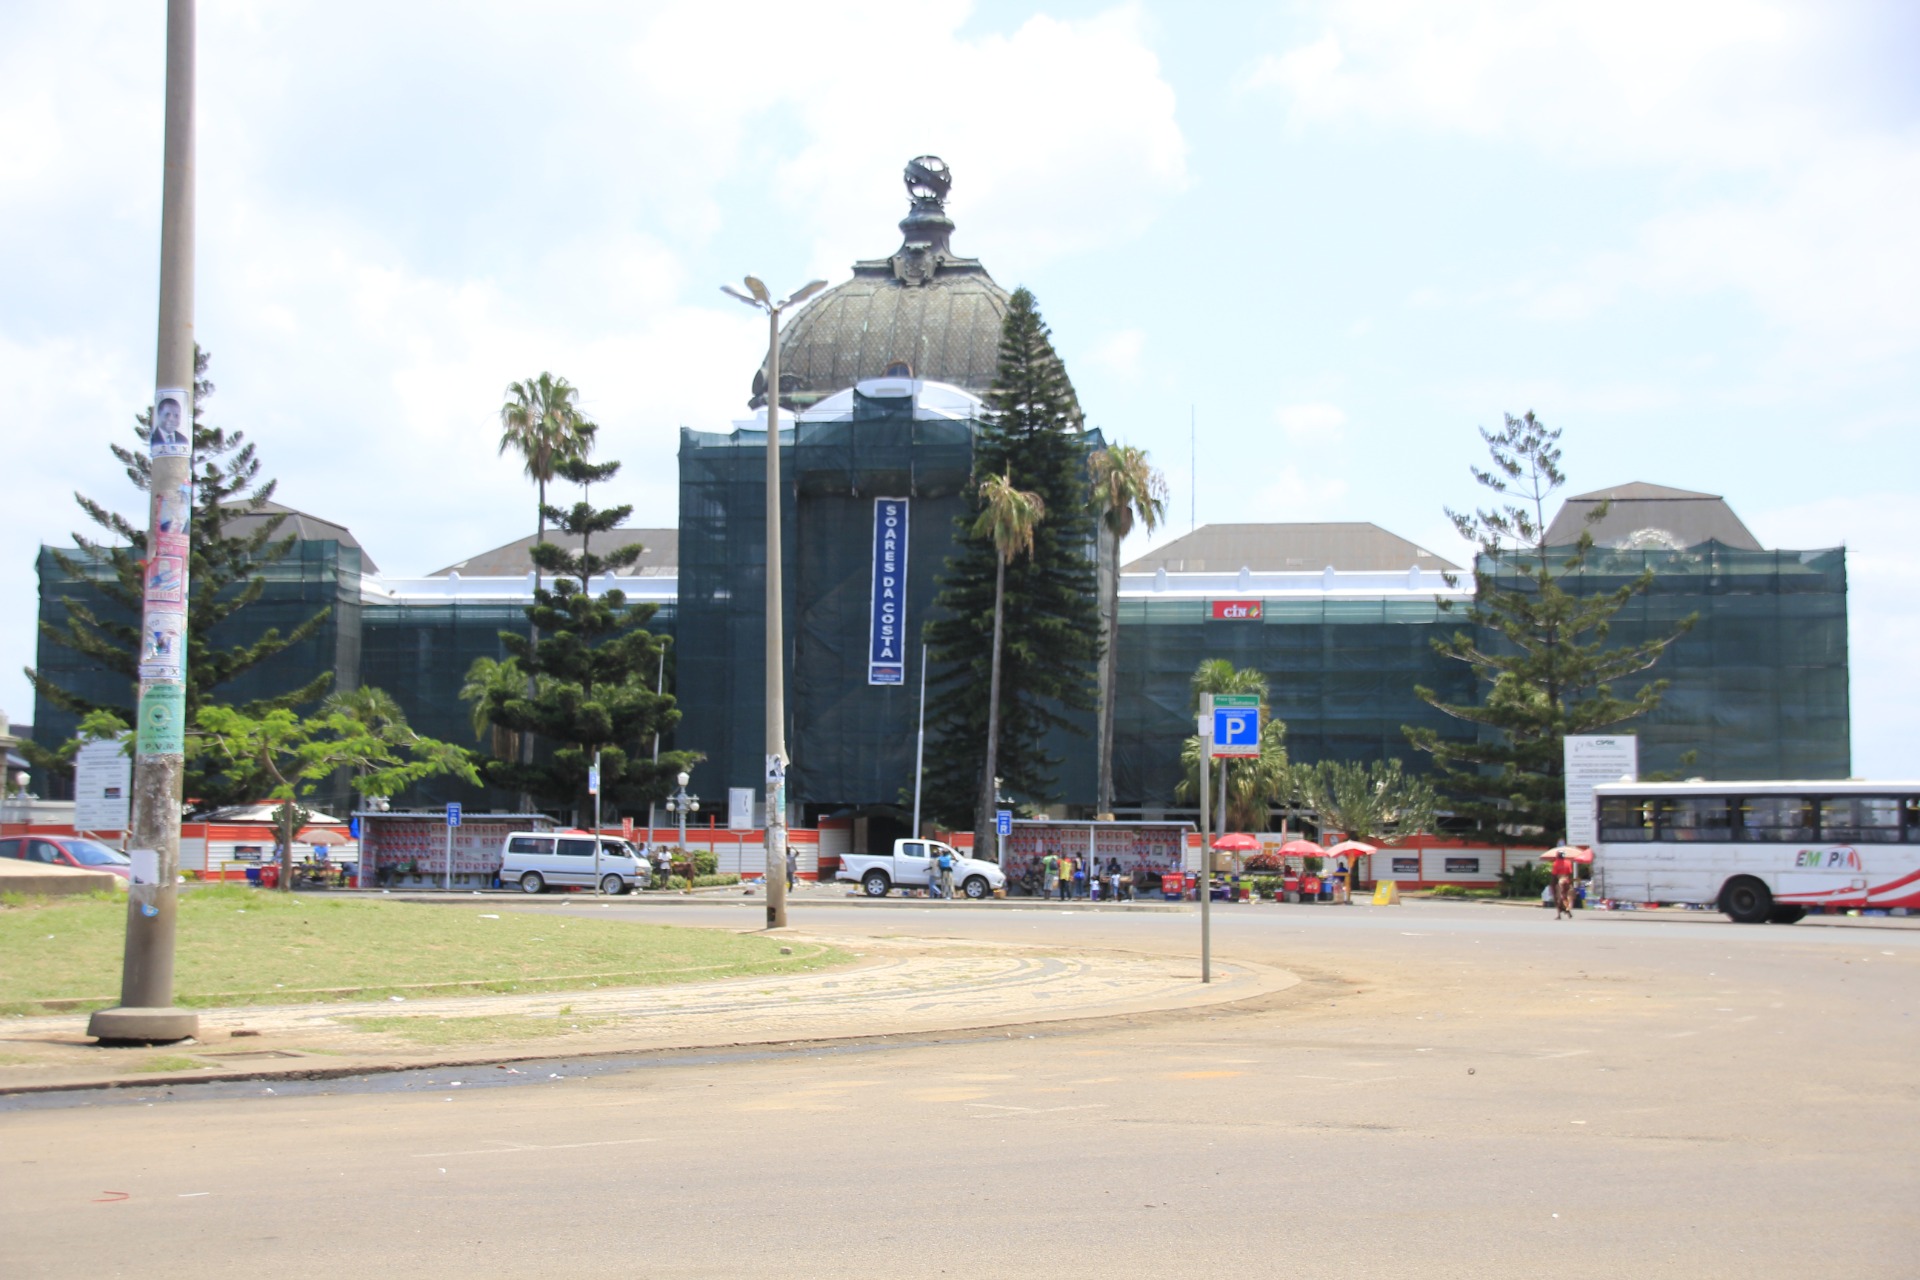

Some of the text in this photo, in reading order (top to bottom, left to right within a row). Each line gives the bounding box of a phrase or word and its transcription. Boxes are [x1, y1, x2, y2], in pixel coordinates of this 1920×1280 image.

[884, 504, 898, 574] SOARES
[882, 576, 896, 599] DA
[880, 601, 895, 659] COSTA
[1226, 717, 1246, 745] P
